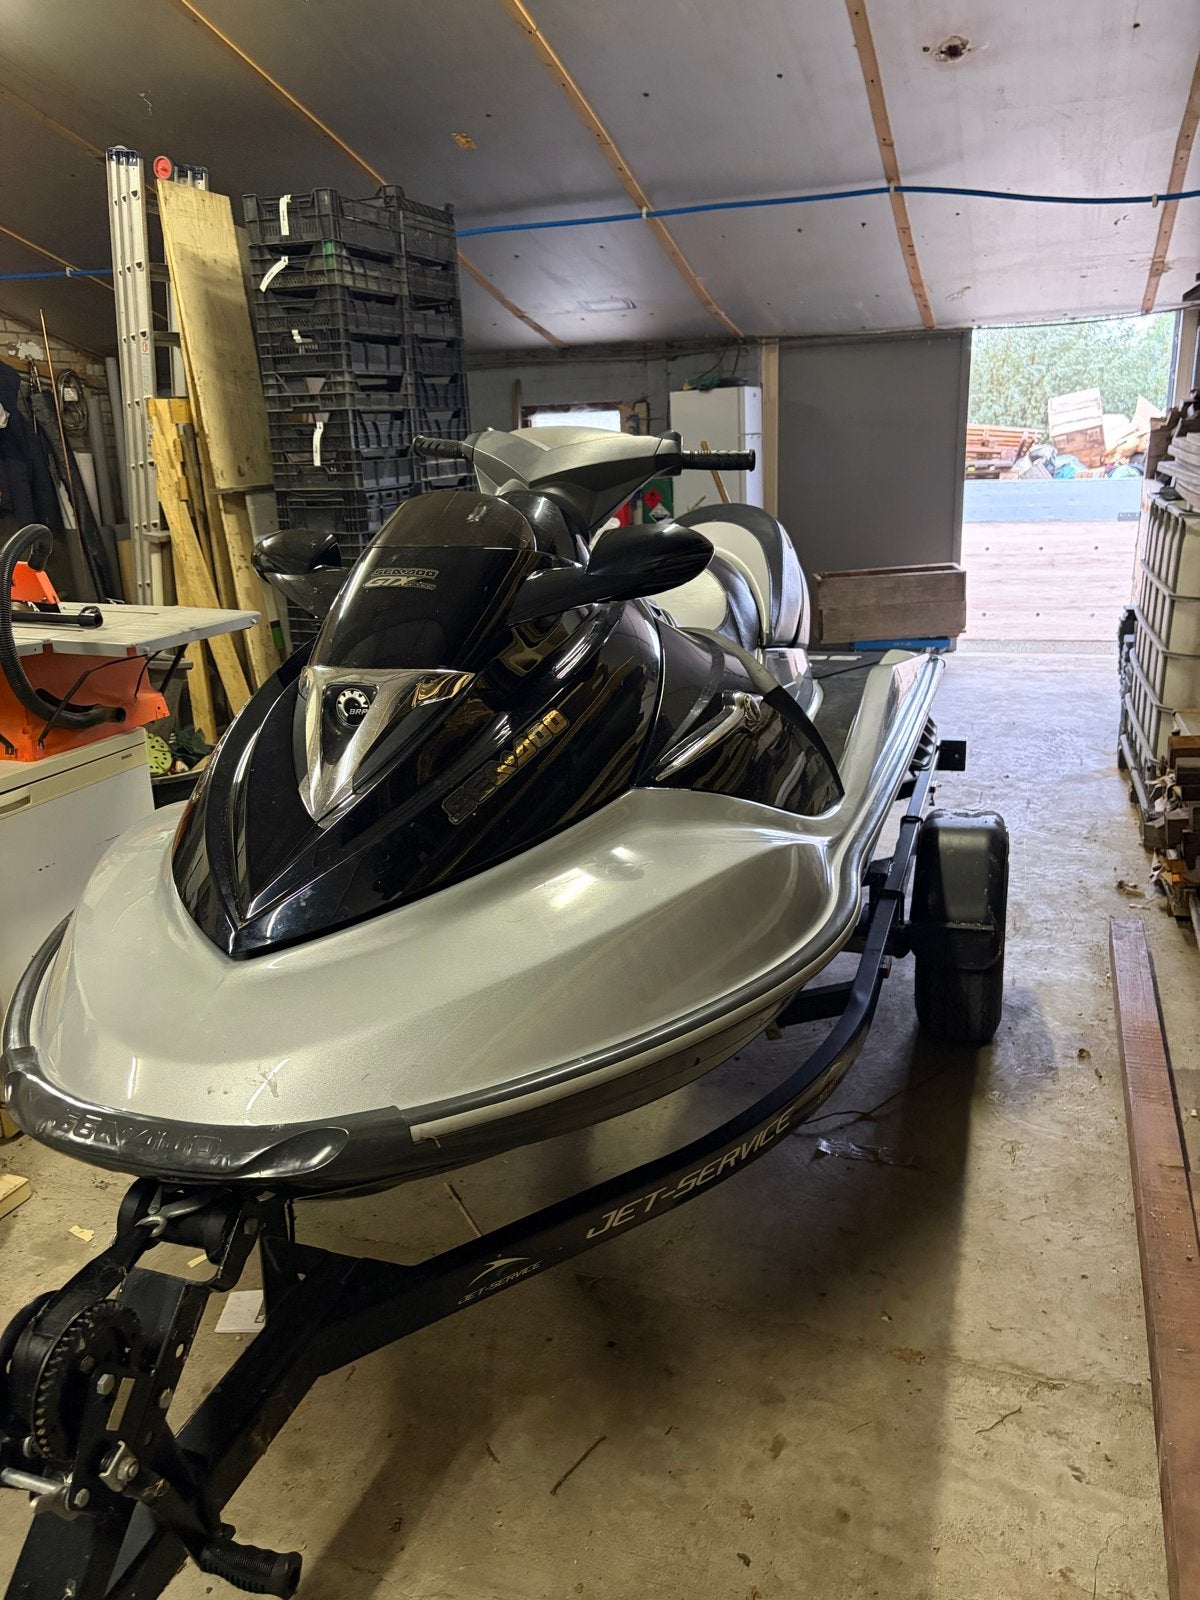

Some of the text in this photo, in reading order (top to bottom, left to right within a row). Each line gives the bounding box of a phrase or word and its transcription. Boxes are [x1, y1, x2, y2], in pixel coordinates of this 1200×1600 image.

[365, 576, 417, 587] GTX
[586, 1105, 795, 1239] JET-SERVICE
[458, 1259, 544, 1305] JET-SERVICE
